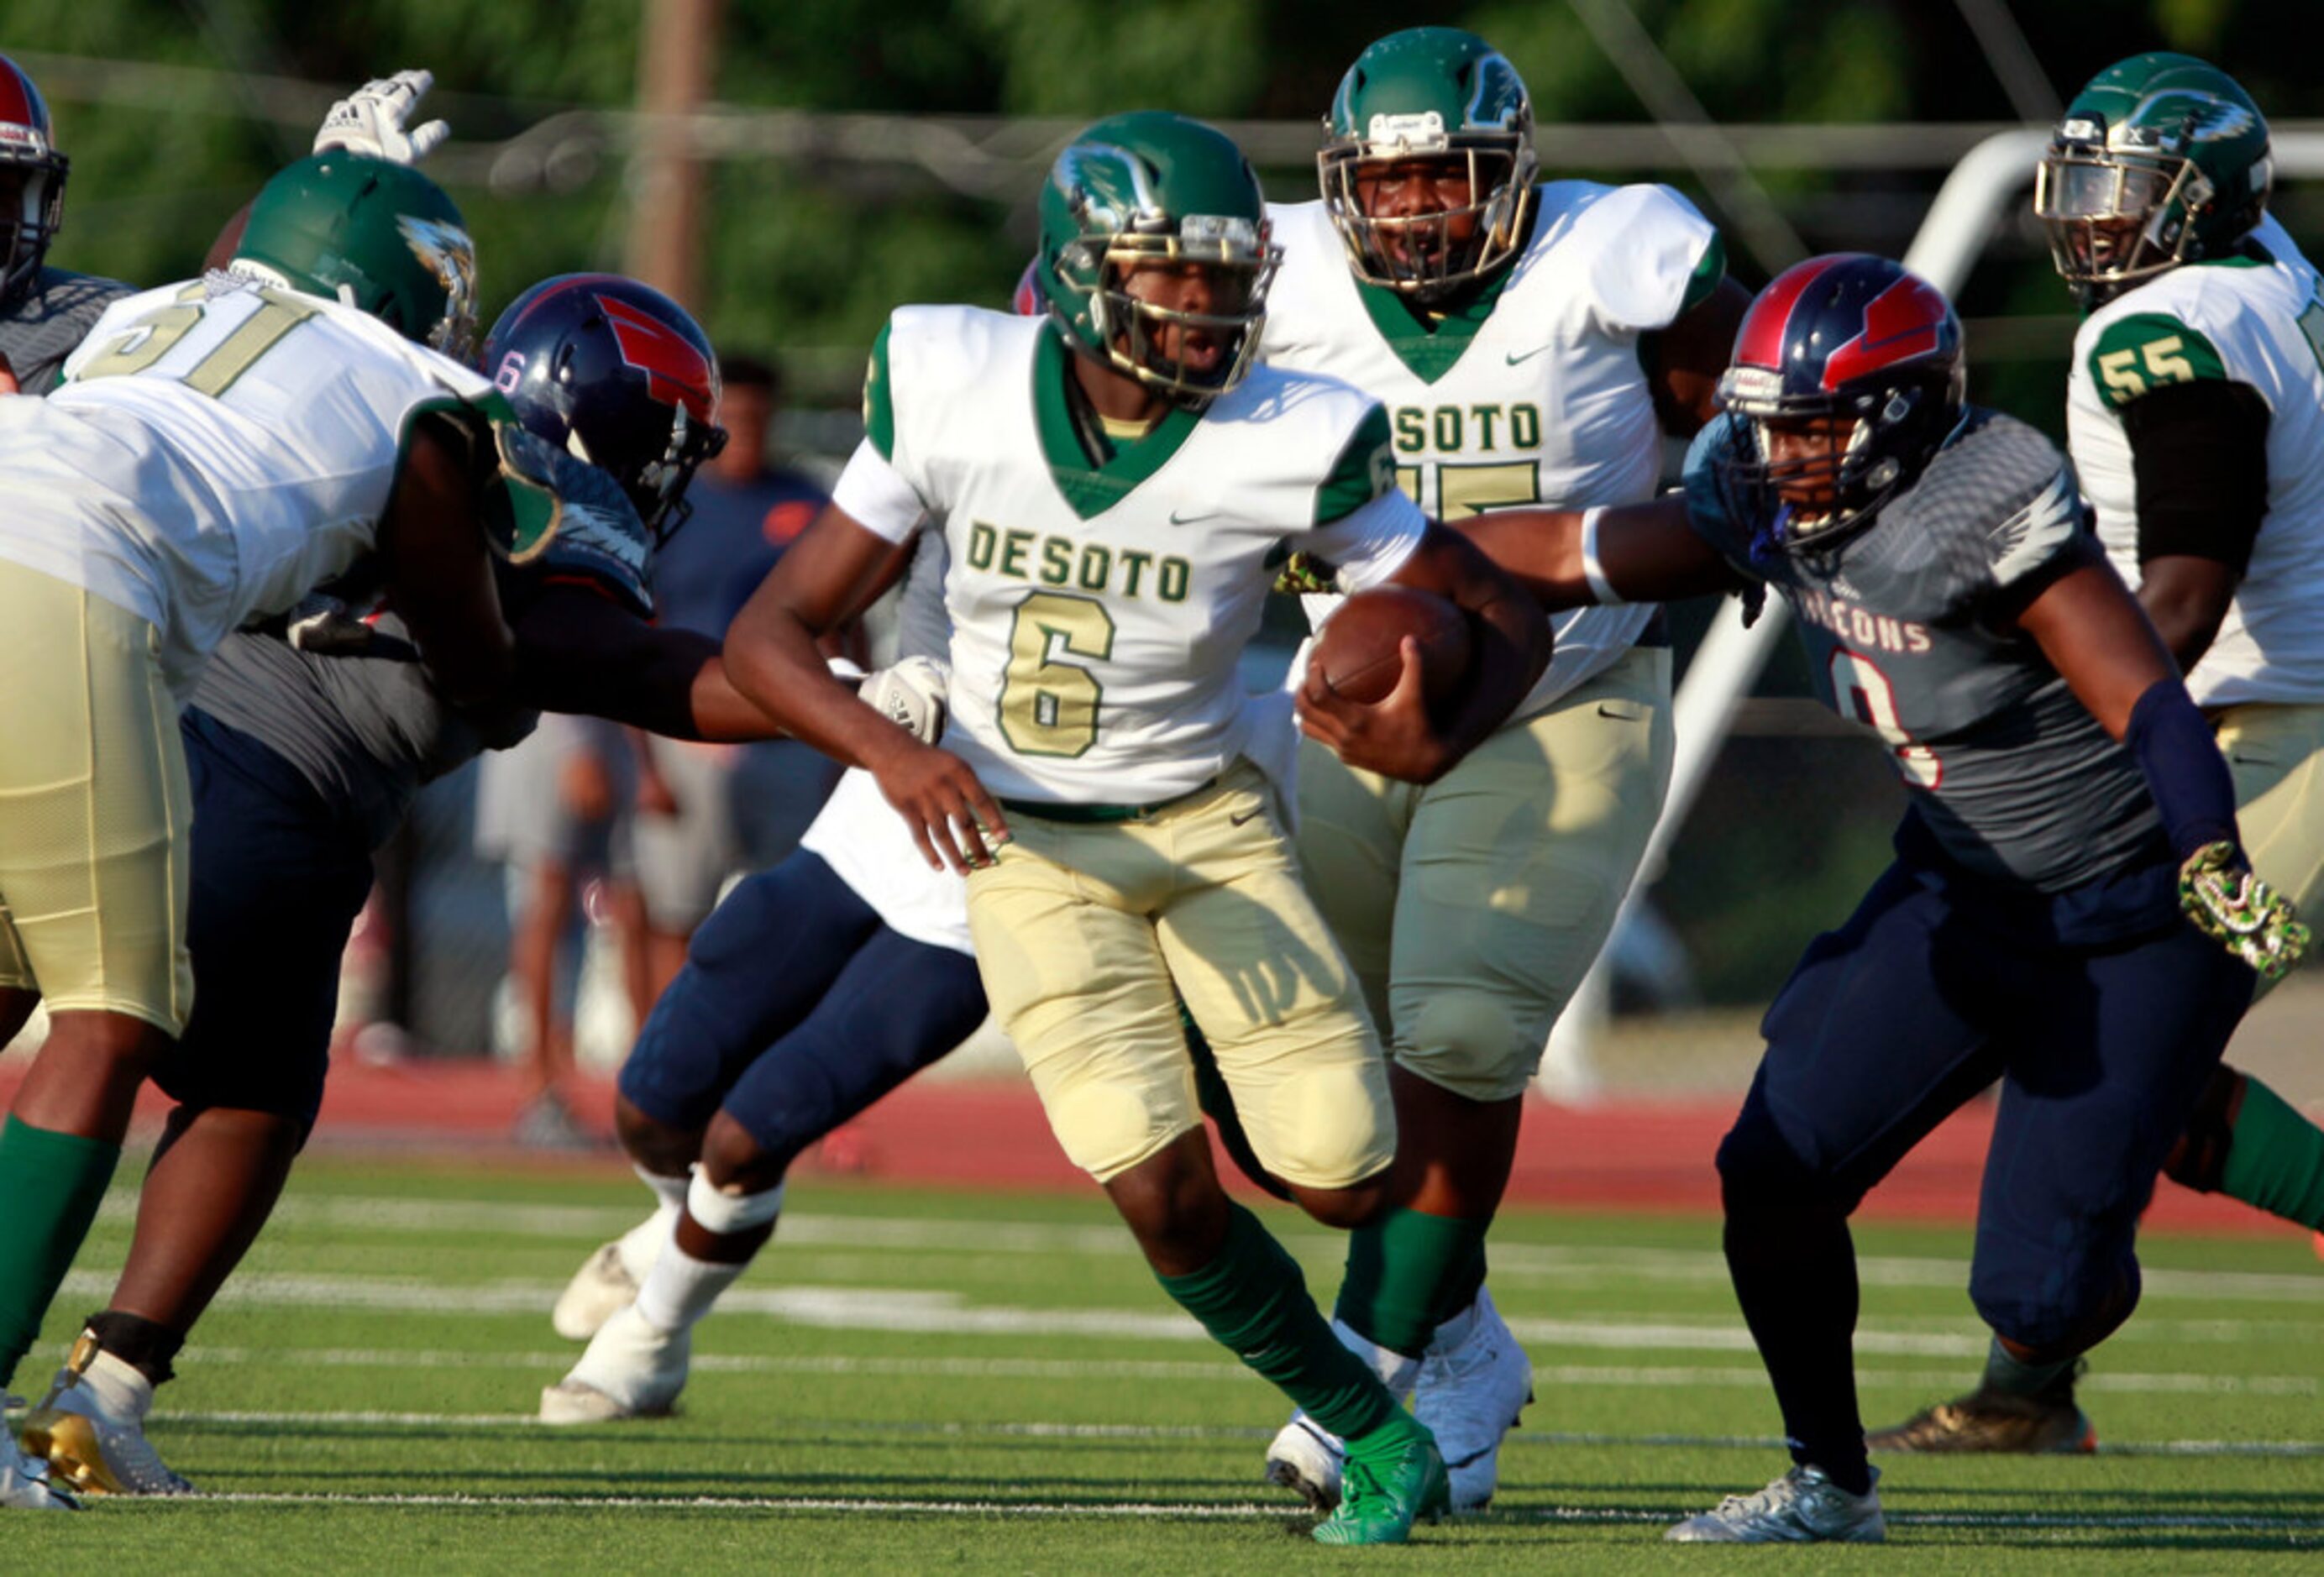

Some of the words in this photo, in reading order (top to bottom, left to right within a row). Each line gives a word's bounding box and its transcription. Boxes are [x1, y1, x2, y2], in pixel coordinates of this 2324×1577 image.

[494, 349, 526, 394] 6
[2098, 334, 2195, 404] 55
[1394, 403, 1542, 453] SOTO
[965, 519, 1193, 605] DESOTO
[995, 589, 1116, 759] 6
